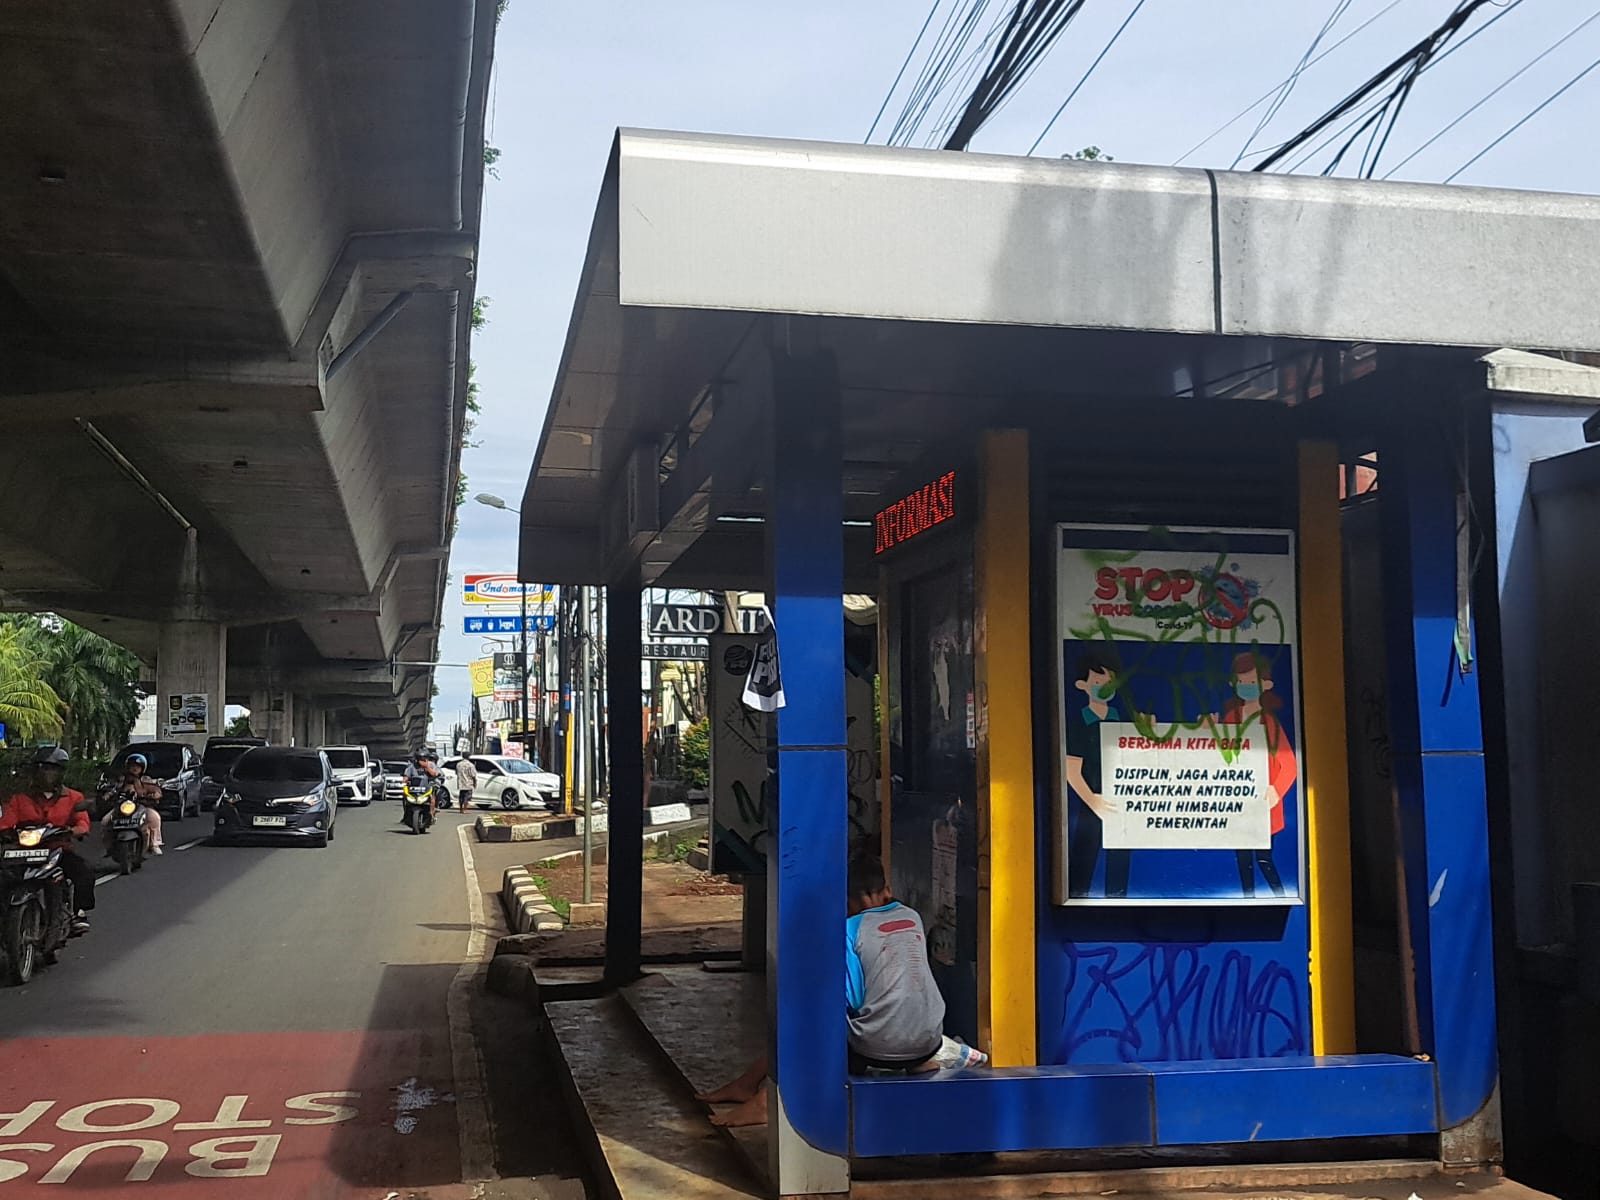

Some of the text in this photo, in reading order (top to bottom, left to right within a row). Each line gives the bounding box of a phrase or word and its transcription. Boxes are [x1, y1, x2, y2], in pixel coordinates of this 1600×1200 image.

[480, 582, 537, 593] Indomaet
[1094, 567, 1195, 602] STOP
[1092, 603, 1133, 617] VIRUS
[1118, 737, 1182, 750] BERSAMA
[1187, 738, 1217, 750] KITA
[1115, 768, 1256, 782] DISIPLIN, JAGA JARAK,
[1114, 784, 1258, 799] TINGKATKAN ANTIBODI,
[1126, 801, 1243, 813] PATUHI HIMBAUAN
[1146, 817, 1228, 829] PEMERINTAH
